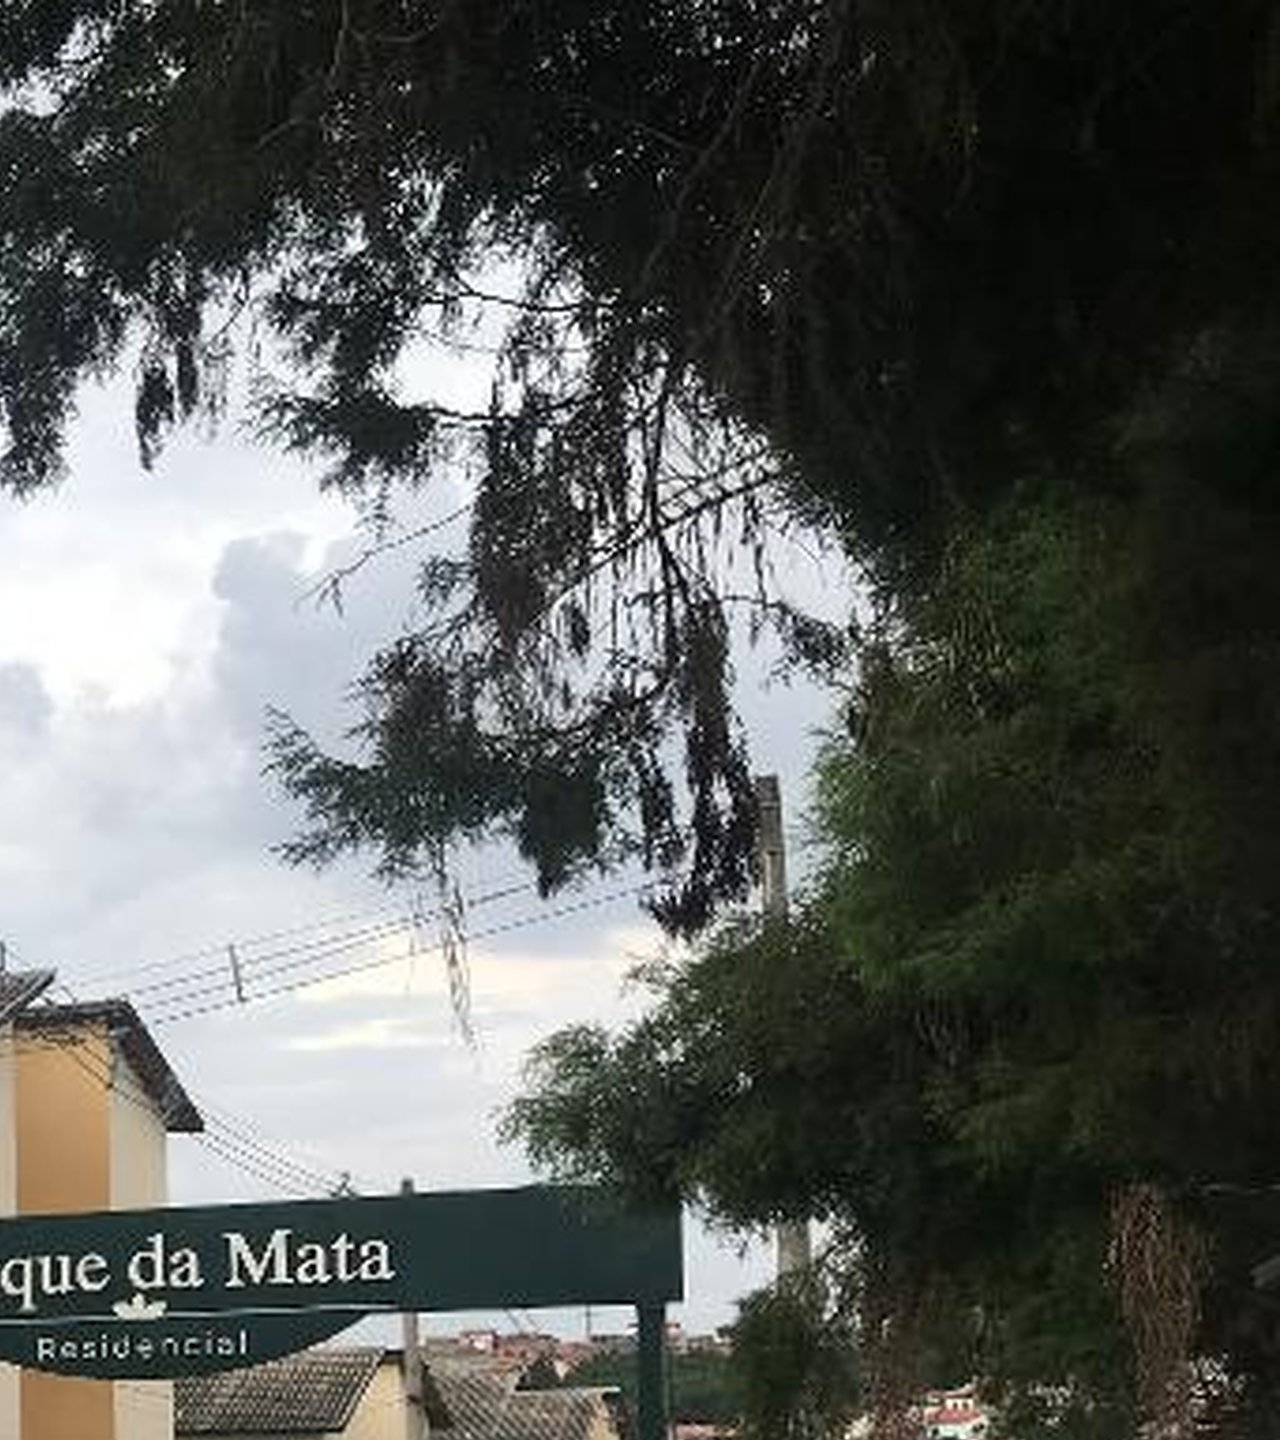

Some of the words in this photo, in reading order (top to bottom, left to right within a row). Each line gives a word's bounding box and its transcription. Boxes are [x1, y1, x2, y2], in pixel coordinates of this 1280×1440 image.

[127, 1233, 205, 1290] da
[223, 1228, 397, 1289] Mata
[36, 1330, 248, 1362] Residencial
